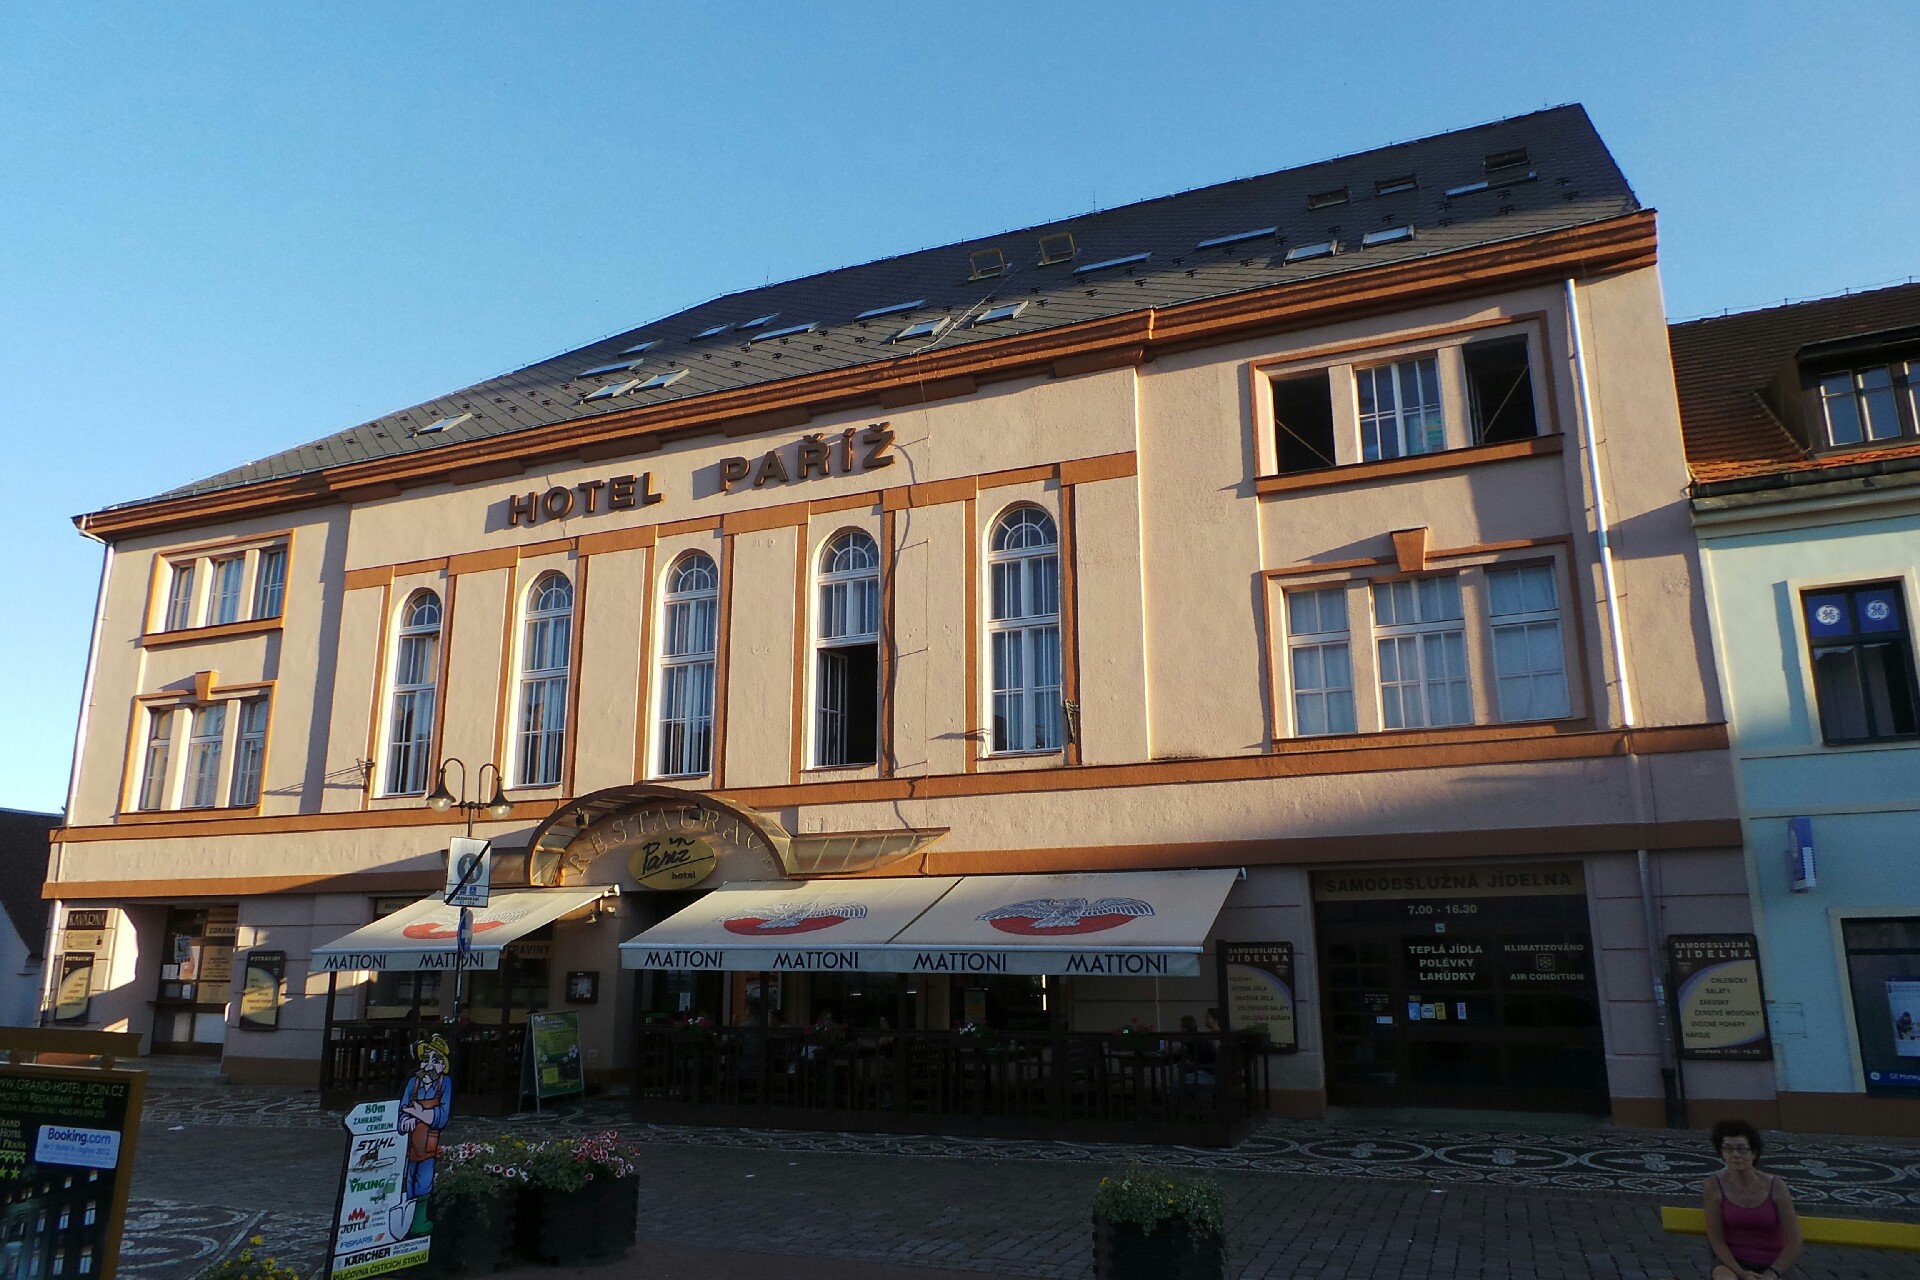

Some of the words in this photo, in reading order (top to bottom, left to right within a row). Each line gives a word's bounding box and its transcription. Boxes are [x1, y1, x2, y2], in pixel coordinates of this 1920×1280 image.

[507, 471, 664, 525] HOTEL
[719, 421, 896, 492] PAŘÍŽ
[671, 870, 696, 880] hotel
[1325, 873, 1480, 894] SAMOOBSLUŽNÁ
[1486, 870, 1572, 889] JÍDELNA
[1407, 905, 1433, 915] 7.00
[1445, 904, 1477, 914] 16.30
[69, 912, 105, 926] KAVÁRNA
[1408, 943, 1447, 954] TEPLÁ
[1448, 943, 1484, 954] JÍDLA
[1674, 941, 1751, 949] SAMOOBSLUŽNÁ
[1228, 954, 1288, 962] JÍDELNA
[1675, 949, 1752, 958] JÍDELNA
[324, 954, 386, 969] MATTONI
[644, 951, 723, 969] MATTONI
[773, 951, 859, 970] MATTONI
[913, 951, 1007, 973] MATTONI
[1066, 953, 1168, 974] MATTONI
[1419, 957, 1474, 968] POLÉVKY
[1419, 970, 1476, 981] LAHŮDKY
[1509, 972, 1527, 981] AIR
[1528, 972, 1584, 981] CONDITION
[365, 1104, 386, 1114] 80m
[366, 1123, 394, 1132] CENTRUM
[48, 1128, 111, 1145] Booking.com
[356, 1137, 396, 1152] STIHL
[350, 1178, 386, 1193] VIKING
[340, 1236, 373, 1248] FISKARS
